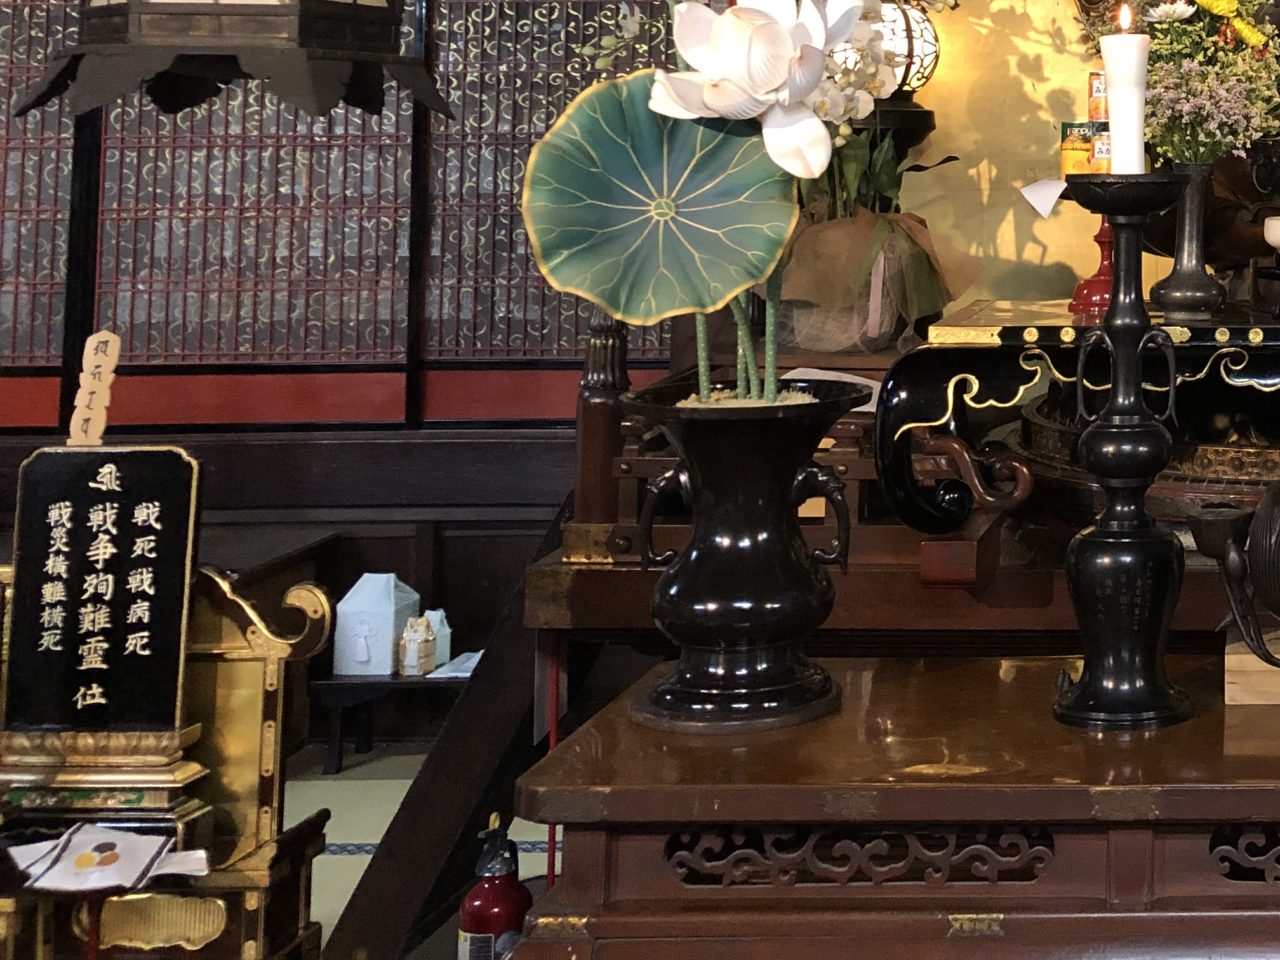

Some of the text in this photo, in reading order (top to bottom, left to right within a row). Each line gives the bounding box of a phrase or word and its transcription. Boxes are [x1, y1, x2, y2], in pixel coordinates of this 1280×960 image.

[123, 501, 163, 656] 戦死戦病死
